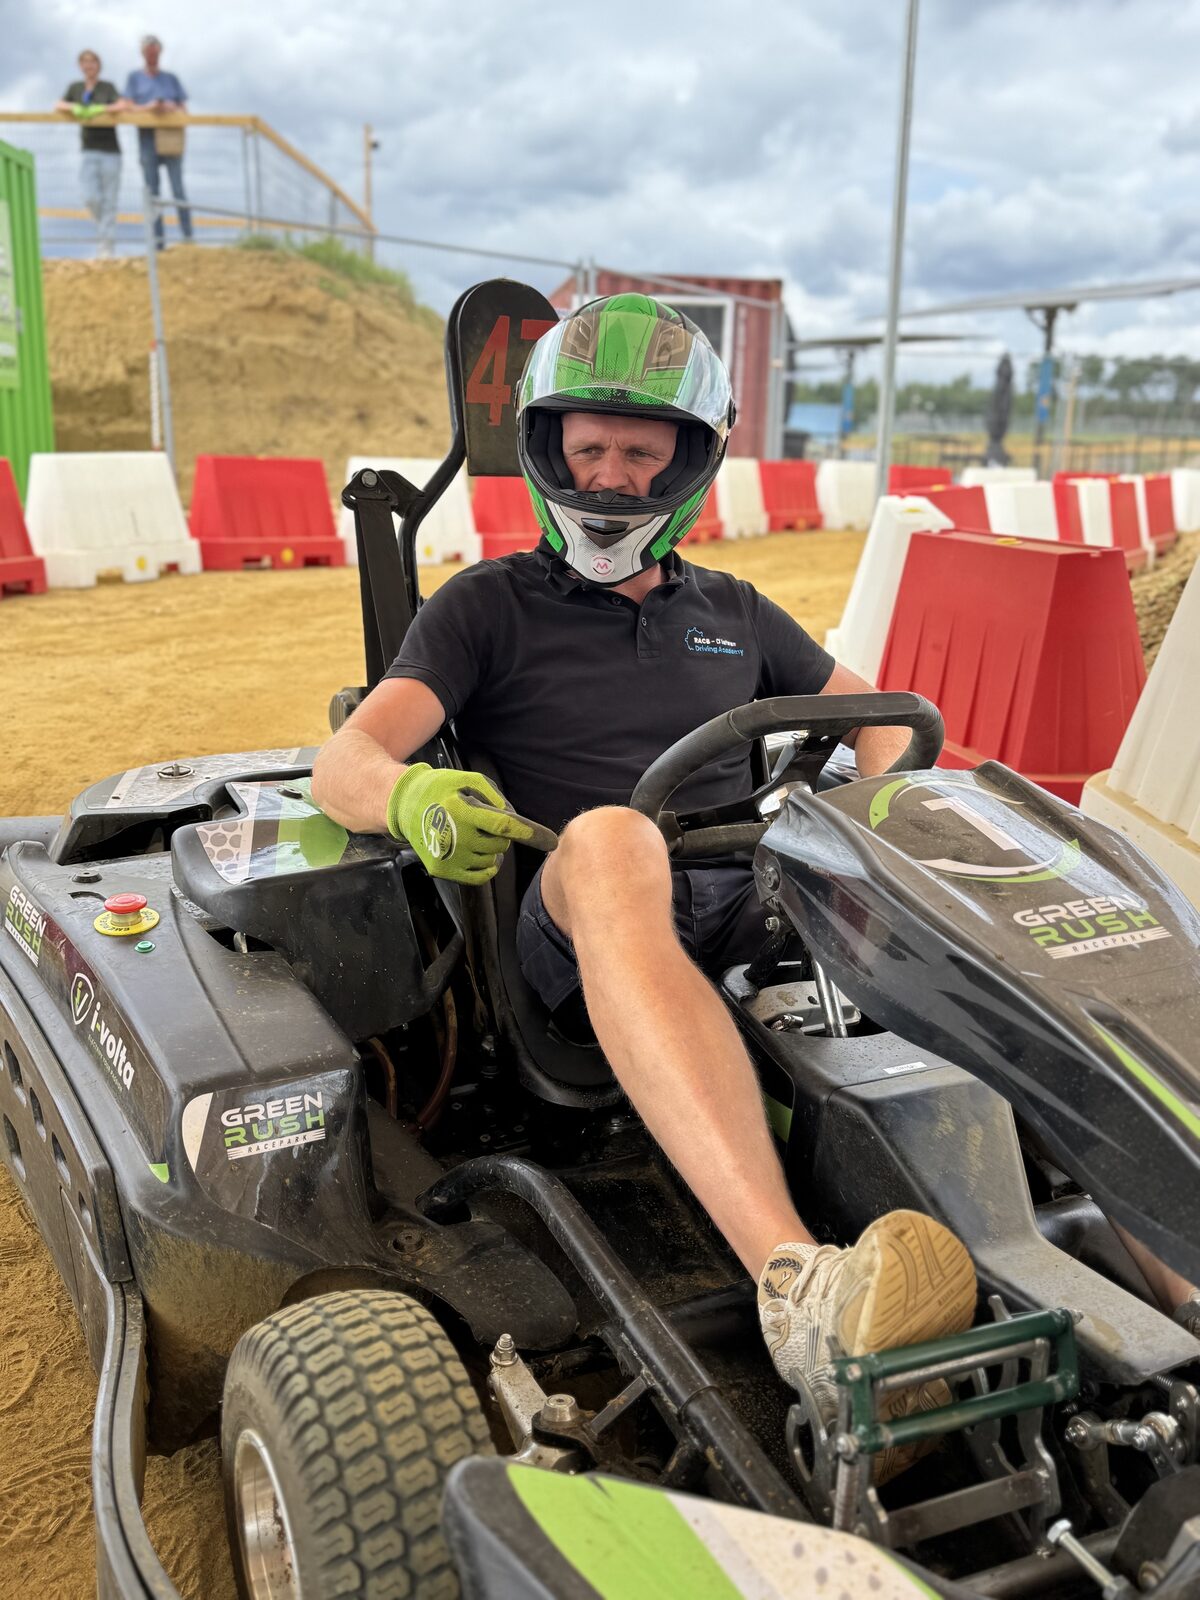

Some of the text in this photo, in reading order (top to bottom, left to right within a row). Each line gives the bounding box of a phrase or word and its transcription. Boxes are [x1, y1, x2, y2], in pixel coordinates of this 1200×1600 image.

[694, 645, 718, 654] Driving
[6, 900, 41, 955] RUSH
[10, 885, 47, 937] GREEN
[1013, 896, 1143, 927] GREEN
[1029, 910, 1160, 947] RUSH
[1072, 933, 1148, 952] RACEPARK
[90, 1001, 135, 1090] i-volta
[220, 1091, 323, 1127] GREEN
[224, 1109, 325, 1147] RUSH
[247, 1135, 307, 1153] RACEPARK
